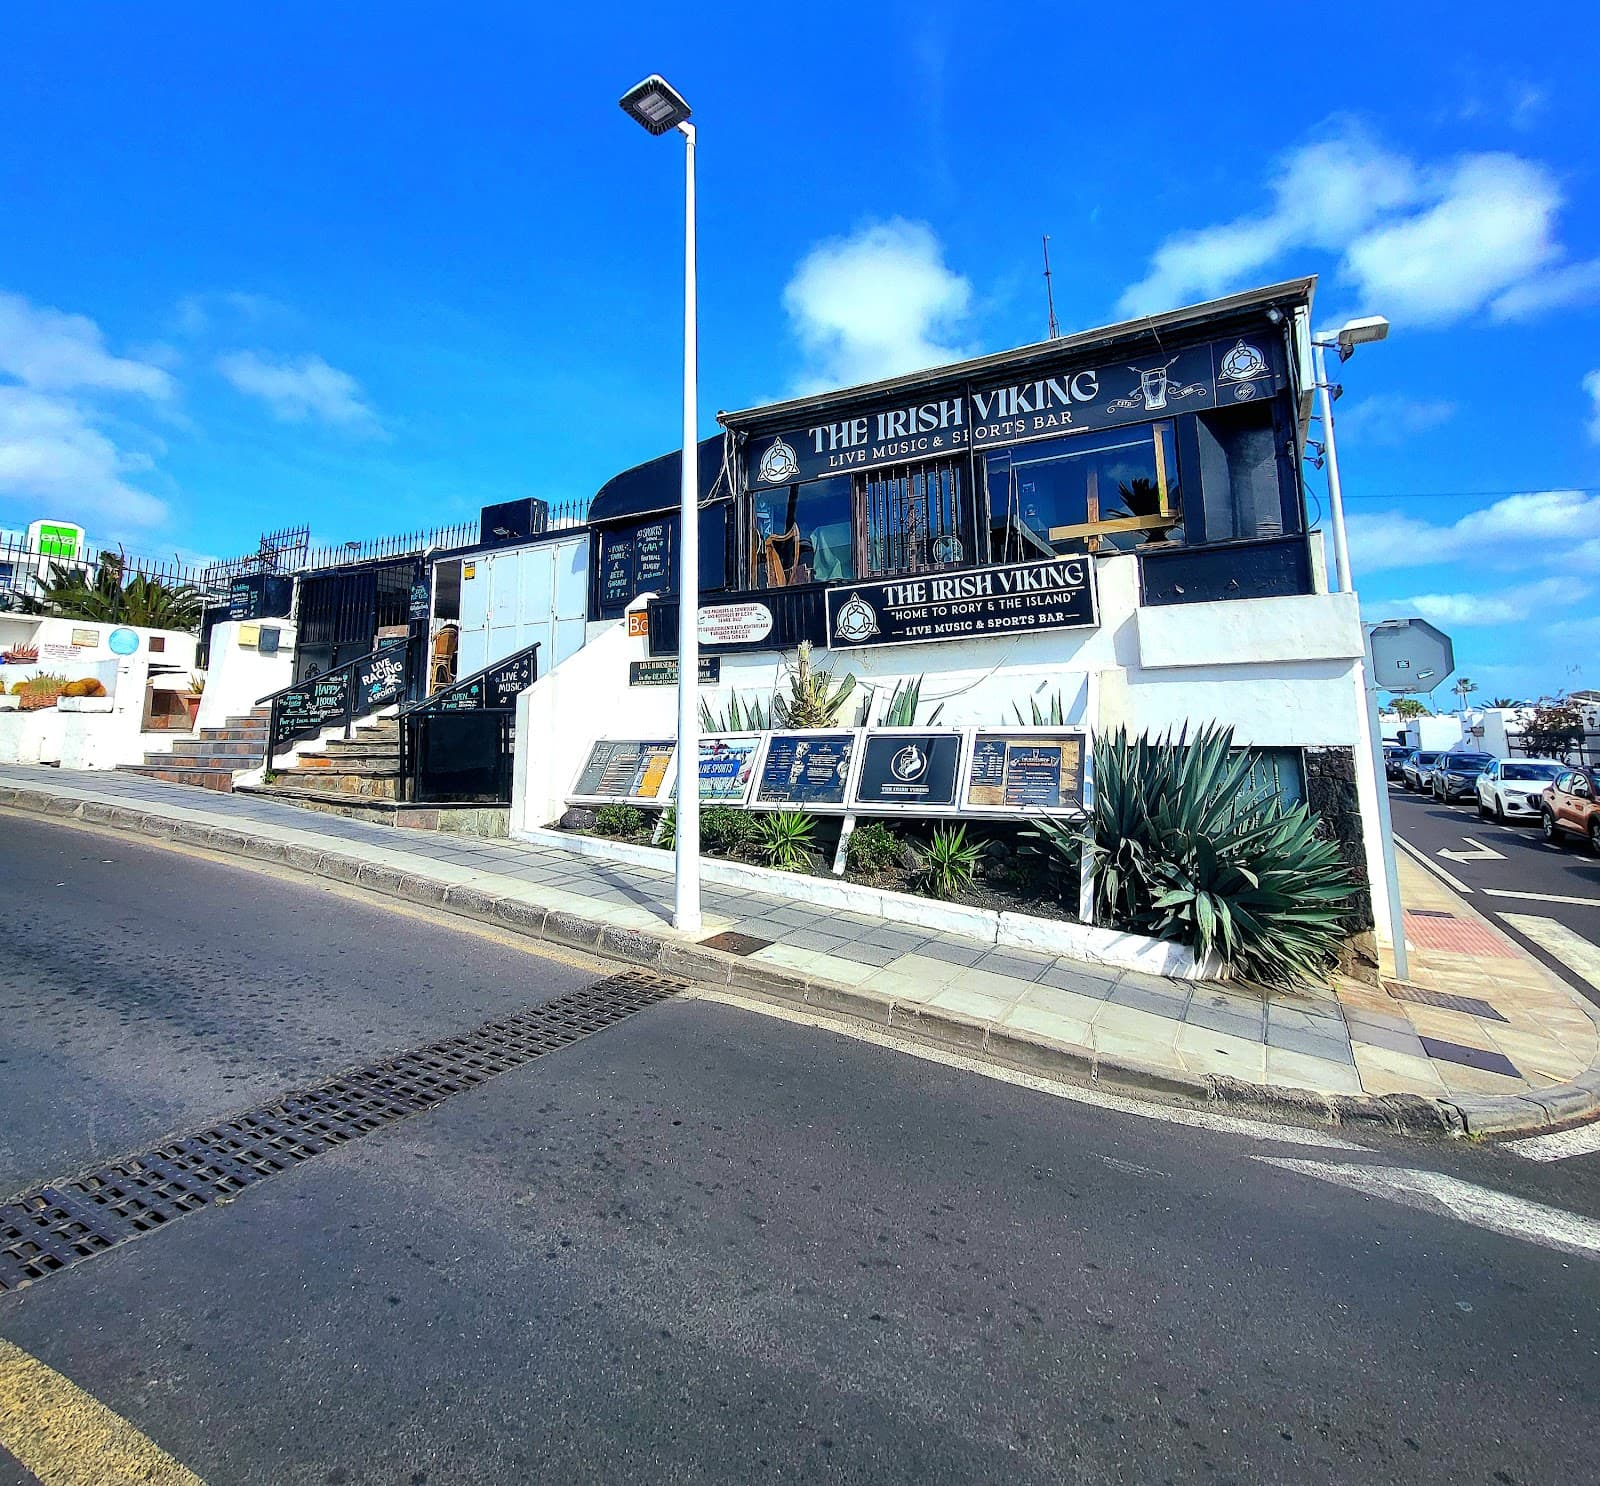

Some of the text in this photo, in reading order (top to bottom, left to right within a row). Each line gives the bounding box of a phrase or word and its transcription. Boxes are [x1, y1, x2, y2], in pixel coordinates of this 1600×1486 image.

[808, 370, 1099, 453] THE IRISH VIKING
[829, 449, 866, 467] LIVE
[872, 437, 928, 459] MUSIC
[932, 435, 944, 448] &
[1033, 411, 1073, 430] BAR
[882, 563, 1084, 606] THE IRISH VIKING
[932, 606, 947, 616] TO
[951, 602, 982, 615] RORY
[999, 598, 1022, 609] THE
[905, 612, 1064, 636] LIVE MUSIC & SPORTS BAR
[370, 657, 391, 673] LIVE
[361, 662, 403, 685] RACING
[501, 671, 518, 682] LIVE
[314, 683, 341, 697] HAPPY
[373, 686, 397, 701] SPORTS
[498, 682, 522, 693] MUSIC
[316, 697, 338, 707] HOUR
[452, 692, 468, 701] OPEN
[711, 763, 734, 774] SPORTS
